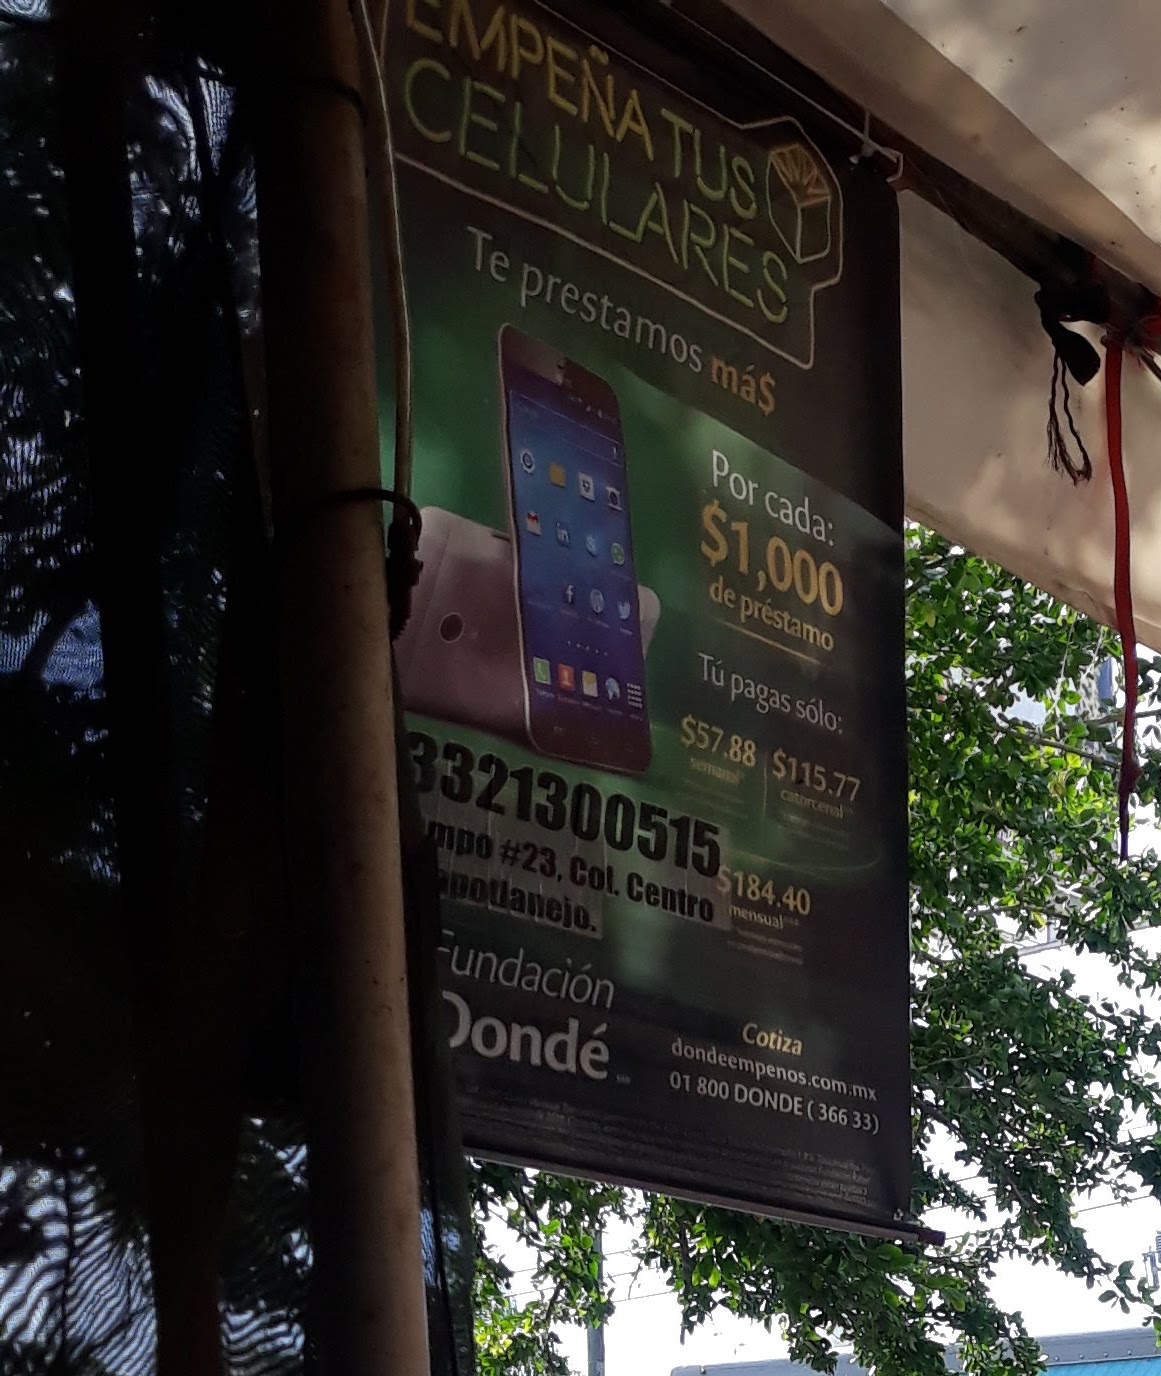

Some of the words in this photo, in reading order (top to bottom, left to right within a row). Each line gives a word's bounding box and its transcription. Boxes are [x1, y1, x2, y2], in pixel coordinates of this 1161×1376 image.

[405, 0, 654, 162] EMPEÑA
[661, 108, 758, 221] TUS
[403, 57, 789, 325] CELULARES
[466, 225, 510, 283] Te
[519, 261, 703, 373] prestamos
[709, 353, 777, 416] má$
[711, 449, 759, 506] Por
[763, 496, 835, 548] cada:
[700, 498, 845, 618] $1,000
[709, 575, 736, 609] de
[698, 652, 725, 687] Tú
[731, 672, 791, 715] pagas
[795, 697, 843, 735] sólo:
[680, 714, 757, 768] $57.88
[772, 748, 862, 802] $115.77
[405, 731, 722, 878] 3321300515
[501, 839, 562, 883] #23,
[570, 854, 619, 896] Col.
[626, 871, 714, 923] Centro
[717, 865, 811, 916] $184.40
[670, 1036, 878, 1101] dondeempenos.com.mx
[741, 1022, 803, 1056] Cotiza
[669, 1071, 691, 1092] 01
[697, 1075, 729, 1100] 800
[734, 1083, 803, 1117] DONDE
